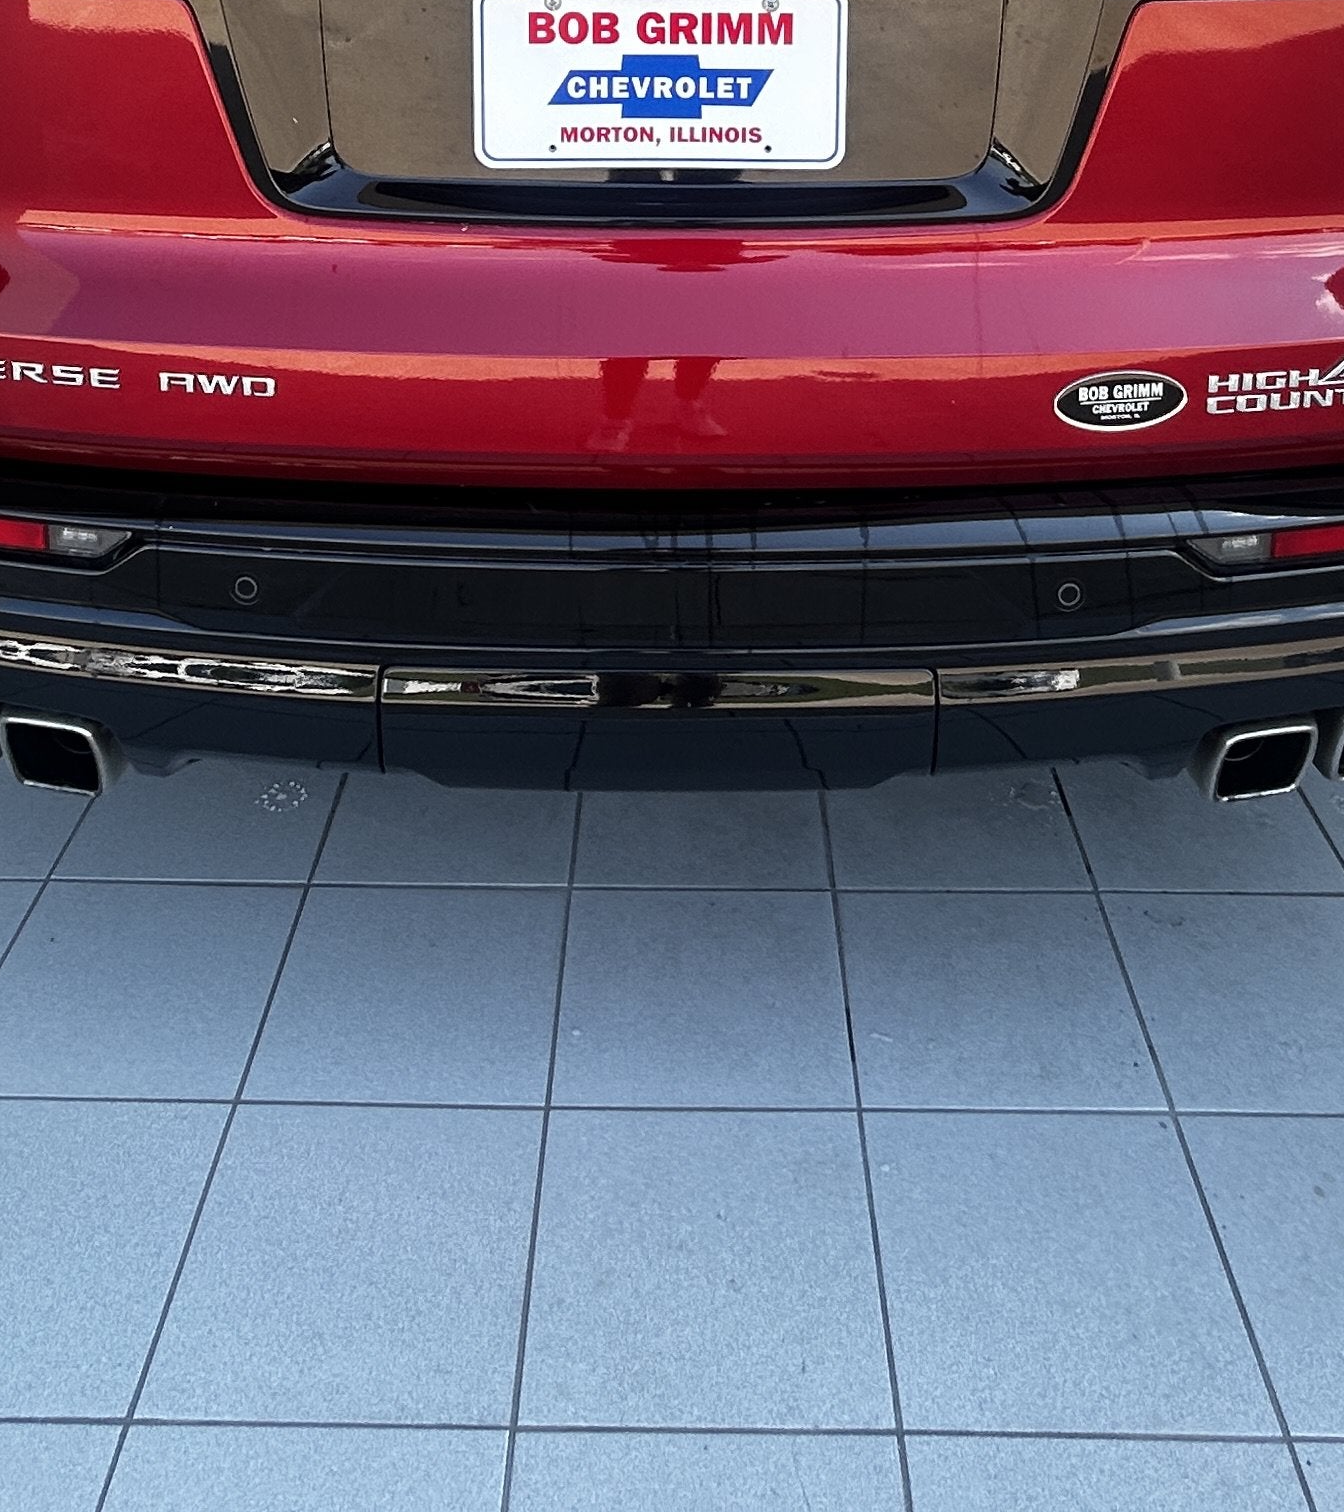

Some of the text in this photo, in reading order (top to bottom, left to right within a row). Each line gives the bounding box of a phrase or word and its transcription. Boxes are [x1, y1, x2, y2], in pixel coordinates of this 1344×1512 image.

[528, 12, 794, 45] BOB GRIMM
[566, 75, 752, 100] CHEVROLET
[560, 126, 763, 146] MORTON, ILLINOIS
[158, 370, 277, 398] AWD
[1078, 382, 1164, 402] BOB GRIMM
[1208, 368, 1319, 394] HIGH
[1092, 401, 1150, 415] CHEVROLET
